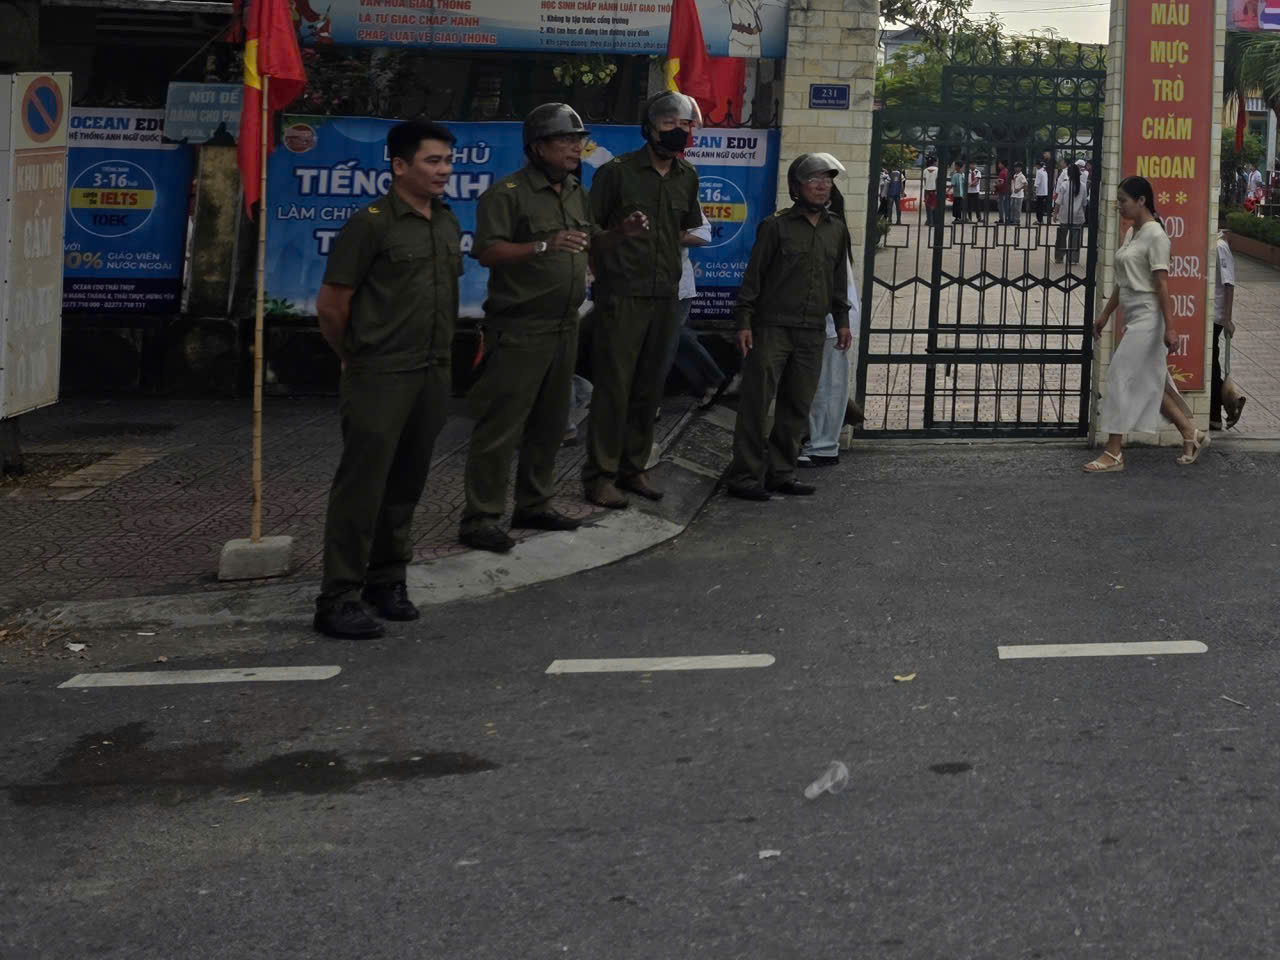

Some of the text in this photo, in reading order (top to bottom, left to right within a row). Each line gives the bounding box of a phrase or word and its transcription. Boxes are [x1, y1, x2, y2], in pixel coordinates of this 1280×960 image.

[1150, 40, 1189, 68] MỰC
[1152, 74, 1185, 102] TRÒ
[71, 116, 130, 129] OCEAN
[1142, 113, 1193, 141] CHĂM
[105, 133, 121, 141] ANH
[692, 136, 758, 149] EAN EDU
[452, 142, 490, 164] HỦ
[701, 150, 715, 158] ANH
[1136, 155, 1196, 179] NGOAN
[16, 164, 40, 192] KHU
[93, 173, 128, 187] 3-16
[443, 173, 492, 199] NH
[100, 192, 138, 206] IELTS
[700, 188, 721, 202] -16
[277, 204, 315, 220] LÀM
[703, 206, 732, 219] ELTS
